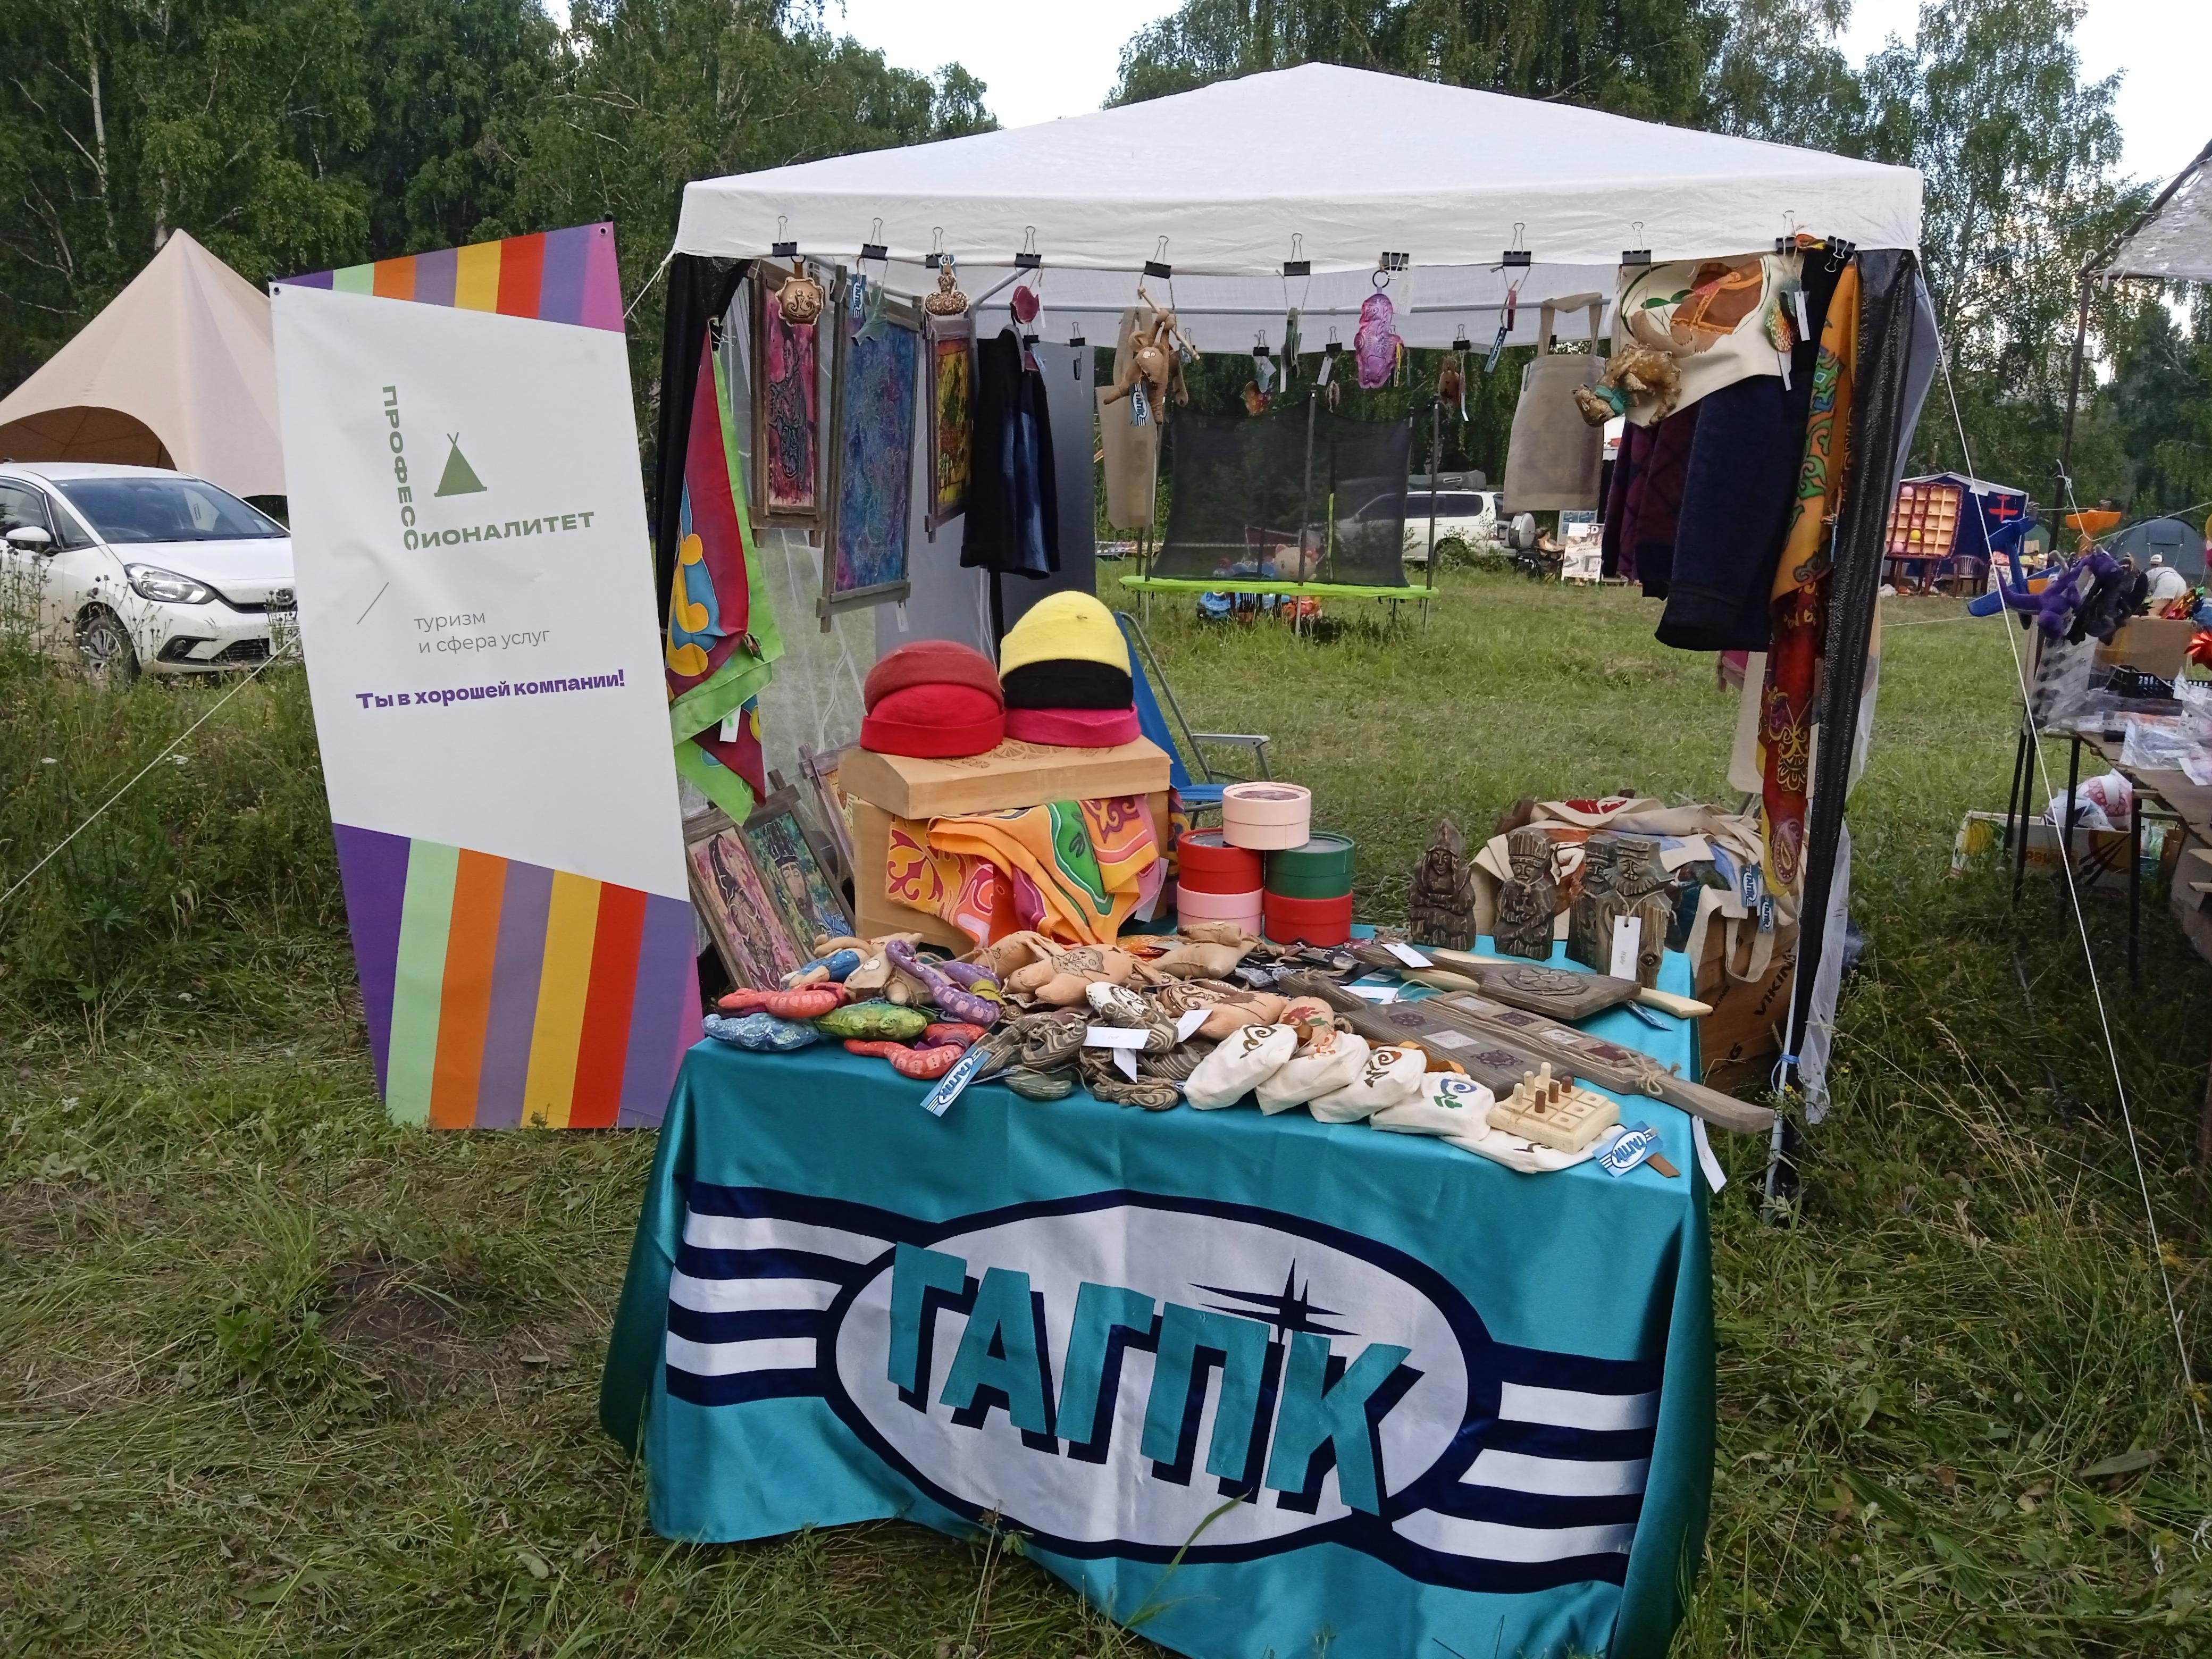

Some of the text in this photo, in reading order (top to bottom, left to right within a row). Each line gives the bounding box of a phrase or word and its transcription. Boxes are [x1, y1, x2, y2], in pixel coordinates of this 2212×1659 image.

[414, 611, 486, 632] туризм
[418, 628, 550, 655] и сфера услуг
[356, 669, 625, 709] Ты в хорошей компании!
[939, 1062, 973, 1100] ГАГПК
[1612, 1135, 1647, 1163] ГАГПК
[887, 1241, 1421, 1517] ГАГПК
